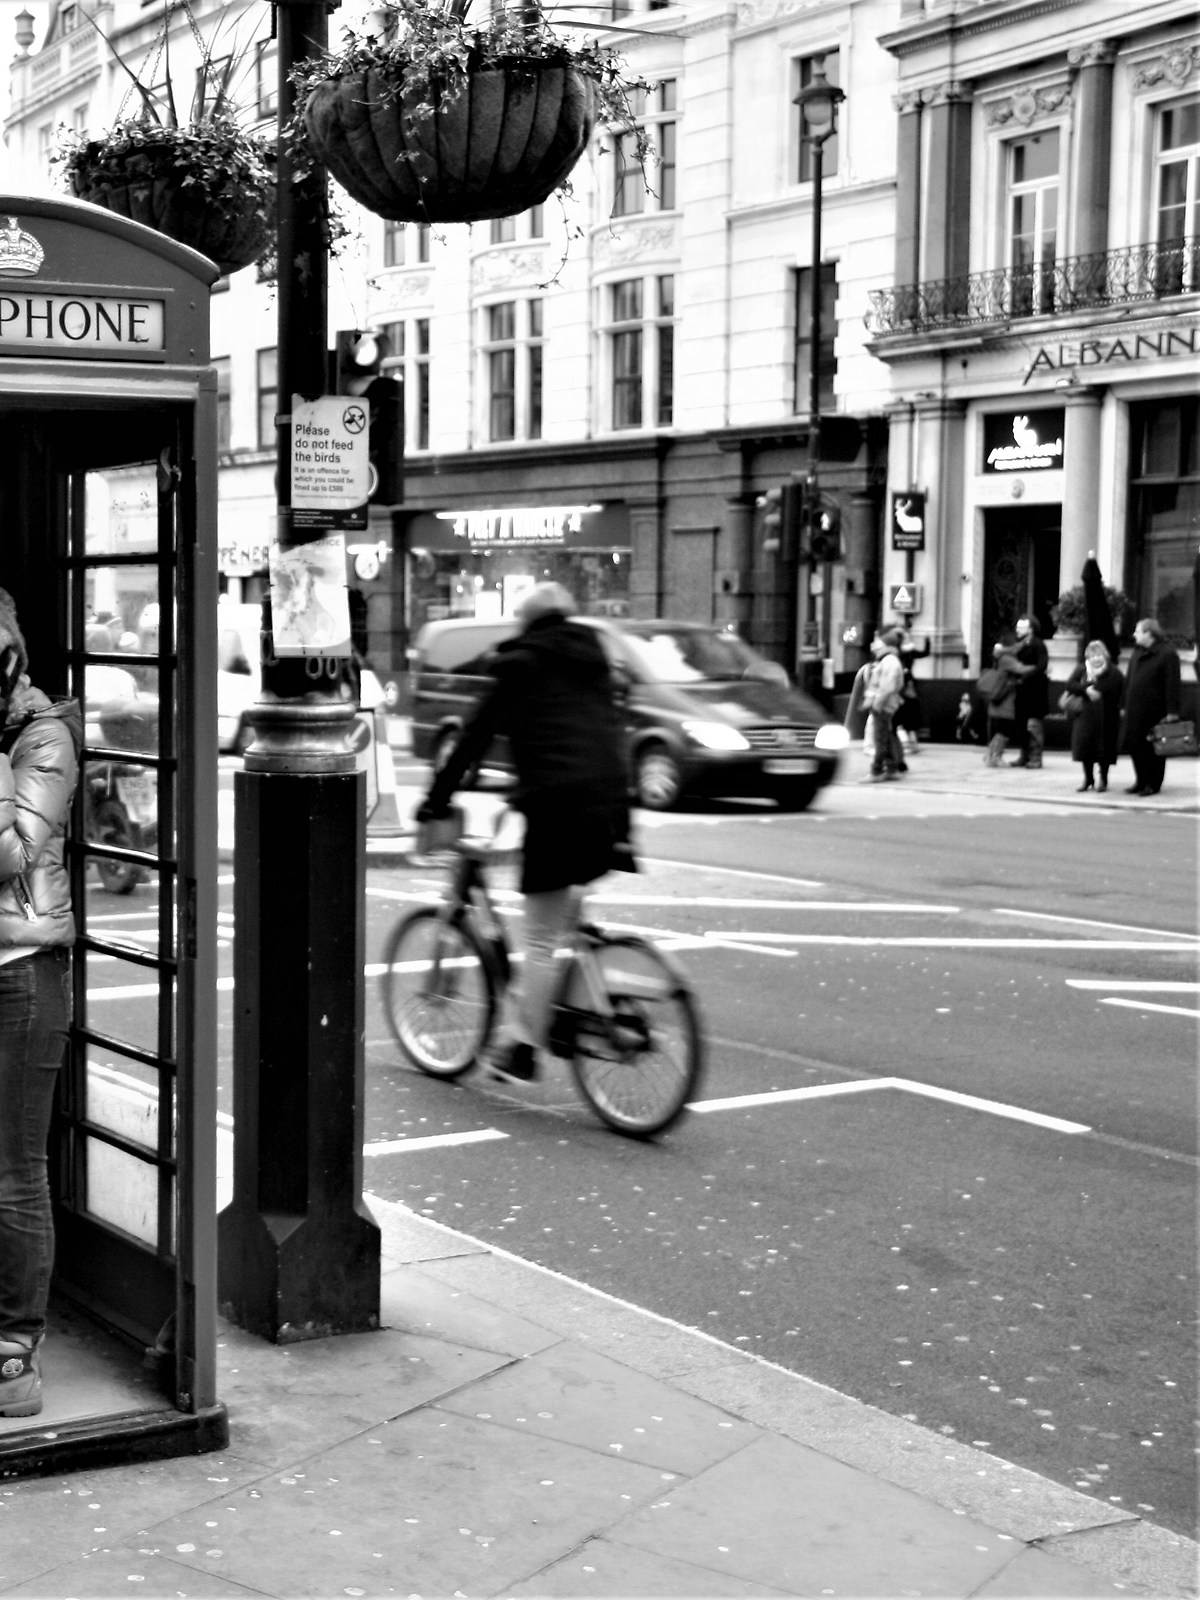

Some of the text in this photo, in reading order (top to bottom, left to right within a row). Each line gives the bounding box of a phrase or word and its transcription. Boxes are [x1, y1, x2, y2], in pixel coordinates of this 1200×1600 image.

[1022, 328, 1200, 386] ALBANN
[295, 423, 330, 436] Please
[295, 438, 353, 451] do not feed
[295, 451, 341, 463] the birds
